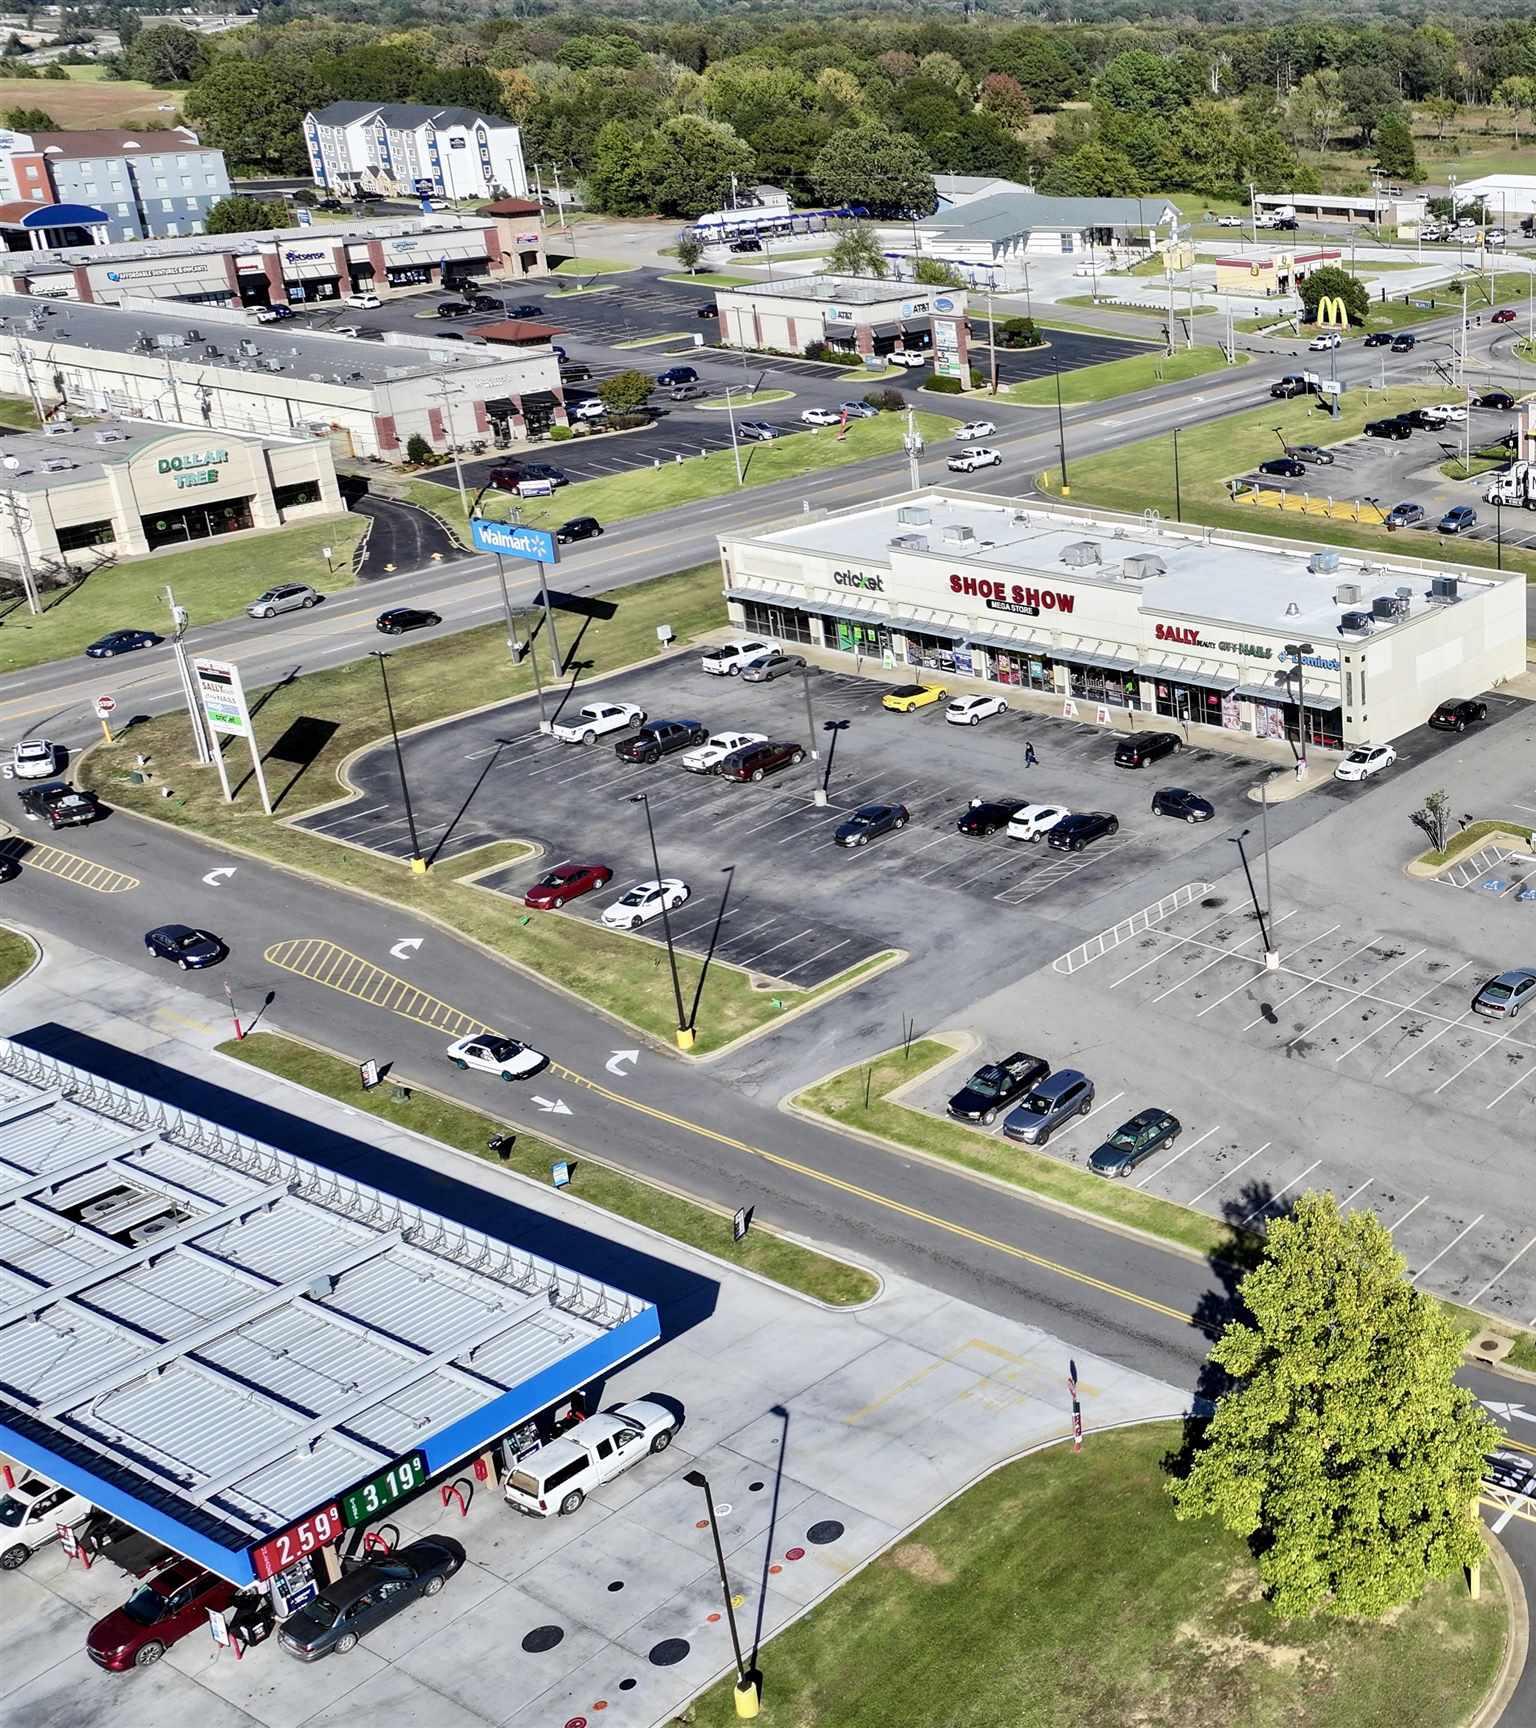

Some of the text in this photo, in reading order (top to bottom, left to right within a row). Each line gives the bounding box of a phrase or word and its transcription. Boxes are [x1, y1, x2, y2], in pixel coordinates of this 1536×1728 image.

[158, 449, 229, 474] DOLLAR
[174, 469, 219, 489] TREE
[479, 526, 531, 553] Walmart
[833, 569, 885, 593] cricket
[950, 574, 1075, 613] SHOE SHOW
[991, 600, 1033, 615] MEGA STORE
[1155, 624, 1200, 646] SALLY
